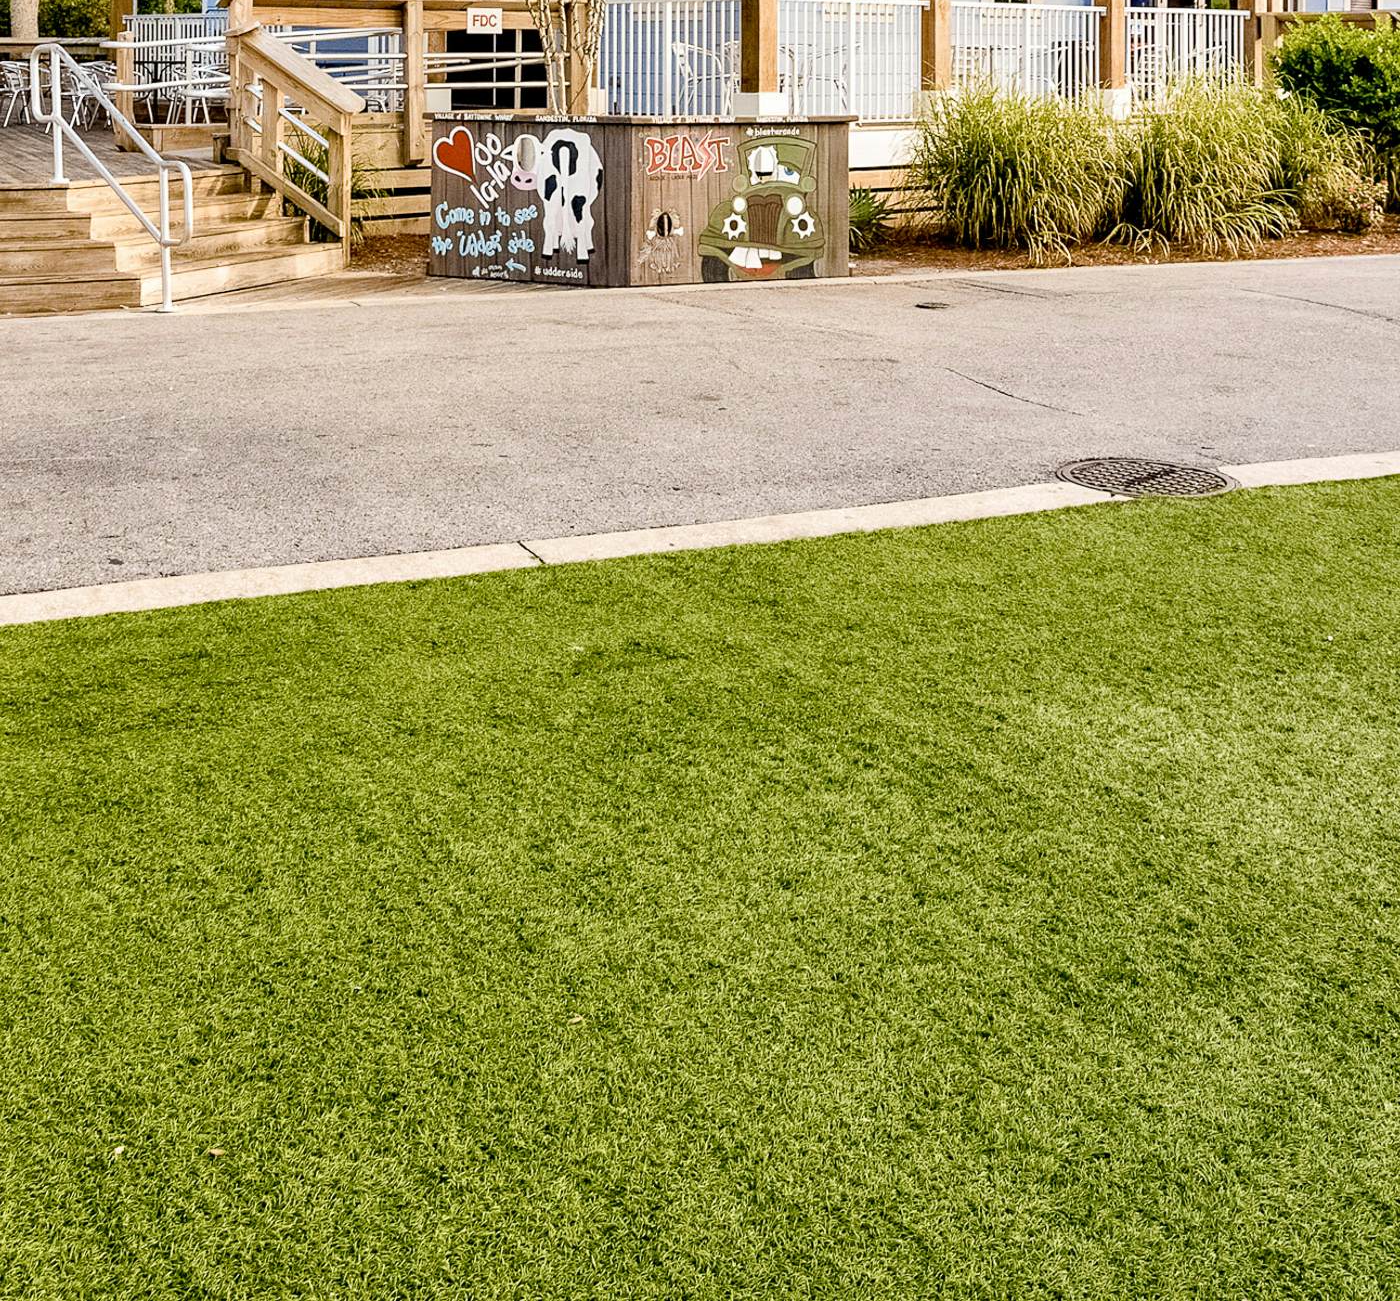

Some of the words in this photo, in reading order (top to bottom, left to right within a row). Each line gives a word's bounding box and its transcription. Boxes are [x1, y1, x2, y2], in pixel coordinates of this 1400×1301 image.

[472, 14, 497, 28] FDC
[644, 129, 730, 182] BLAST
[435, 201, 475, 229] Come
[479, 209, 491, 226] in
[495, 206, 511, 226] to
[514, 204, 538, 225] see
[432, 235, 453, 256] the
[508, 230, 535, 254] side
